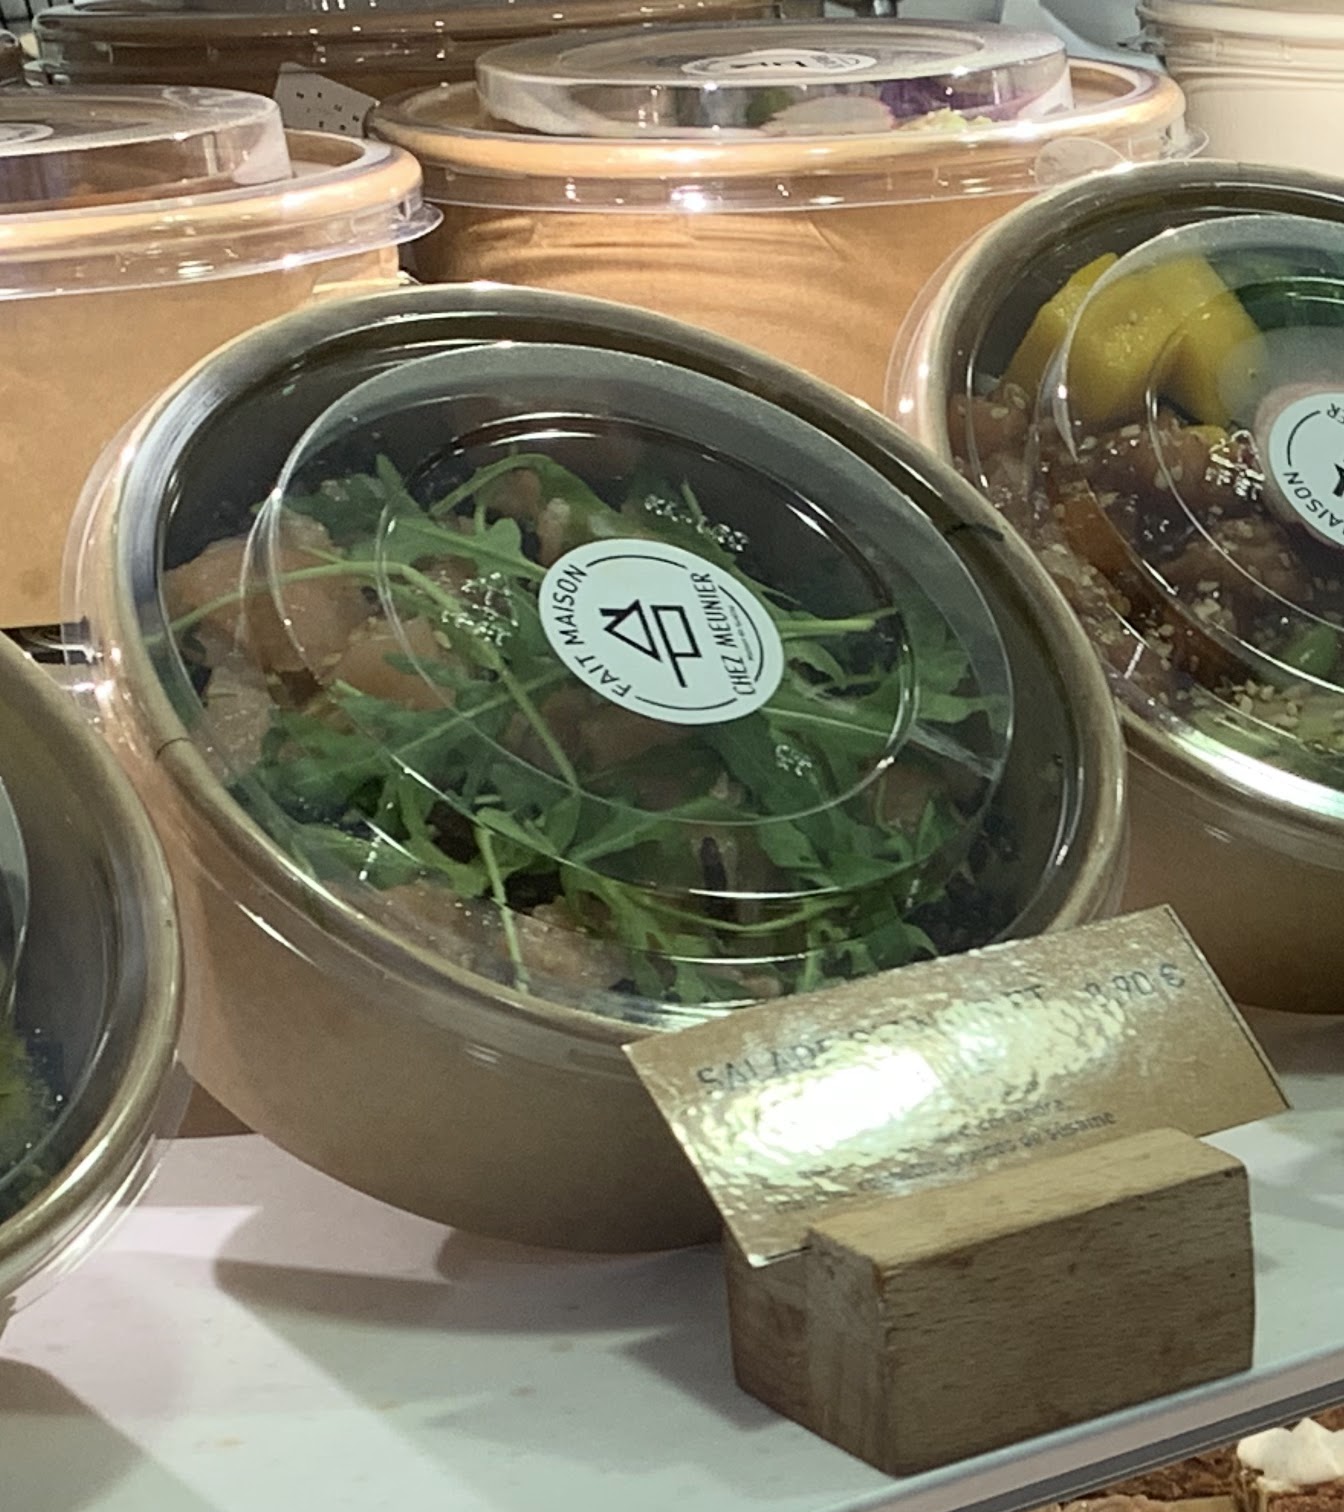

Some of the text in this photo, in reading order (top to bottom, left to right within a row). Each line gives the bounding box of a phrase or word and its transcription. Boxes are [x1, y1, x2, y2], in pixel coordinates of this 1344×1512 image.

[553, 563, 632, 698] FAIT MAISON
[689, 571, 738, 648] MEUNIER
[723, 654, 757, 696] CHEZ
[1159, 963, 1185, 989] €
